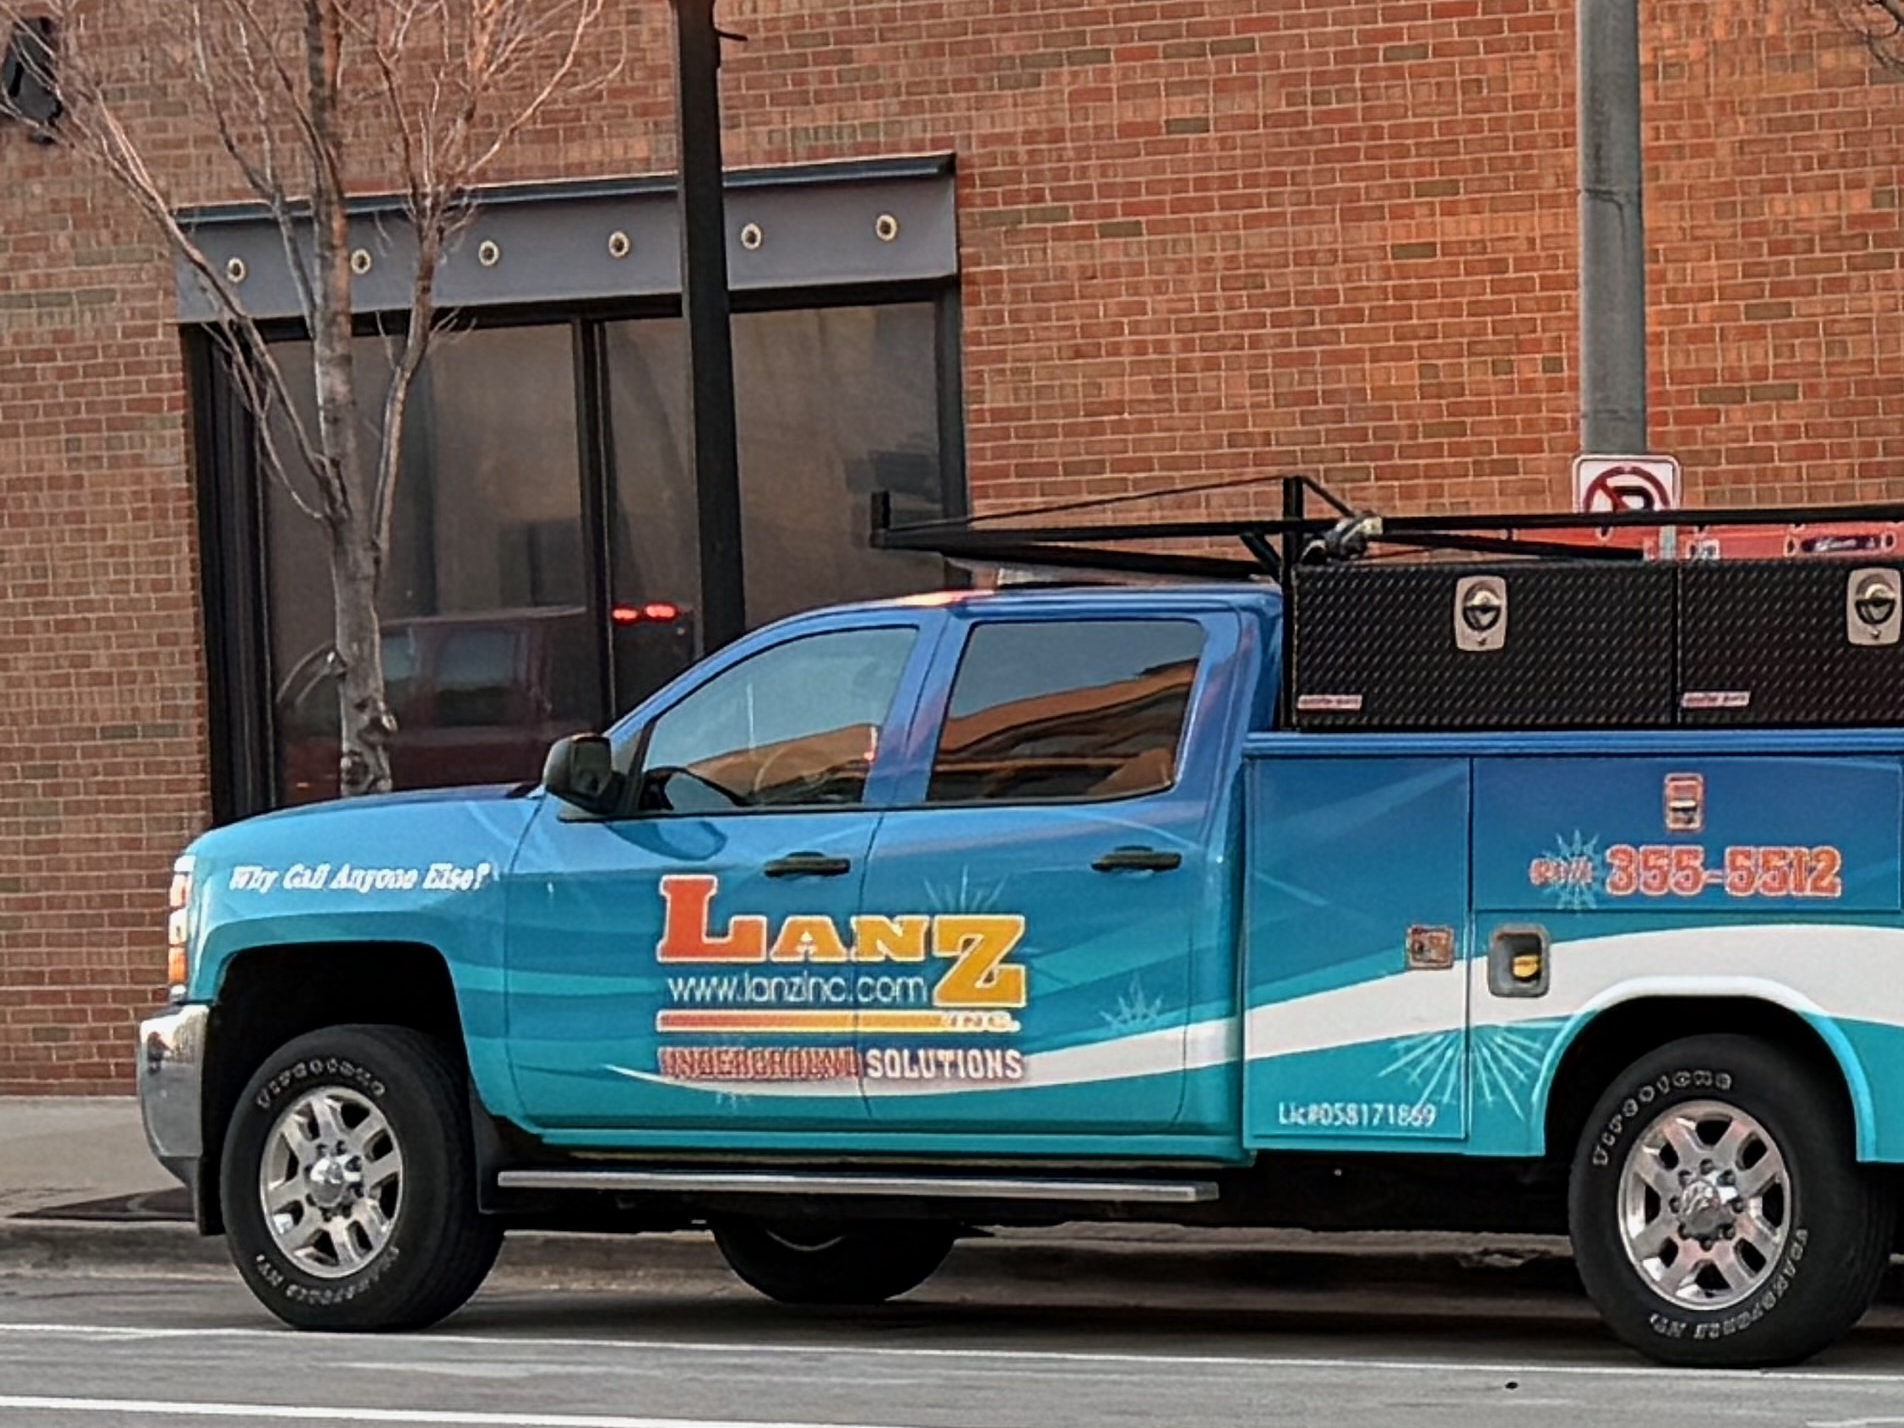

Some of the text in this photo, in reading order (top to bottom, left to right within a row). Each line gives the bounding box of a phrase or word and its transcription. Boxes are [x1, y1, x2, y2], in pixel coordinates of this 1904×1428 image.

[229, 863, 490, 893] Why Call Anyone Else?
[1605, 844, 1842, 898] 355-5512
[668, 971, 928, 1004] www.lanzinc.com
[866, 1048, 1024, 1080] SOLUTIONS
[1279, 1100, 1437, 1128] Lic#058171869
